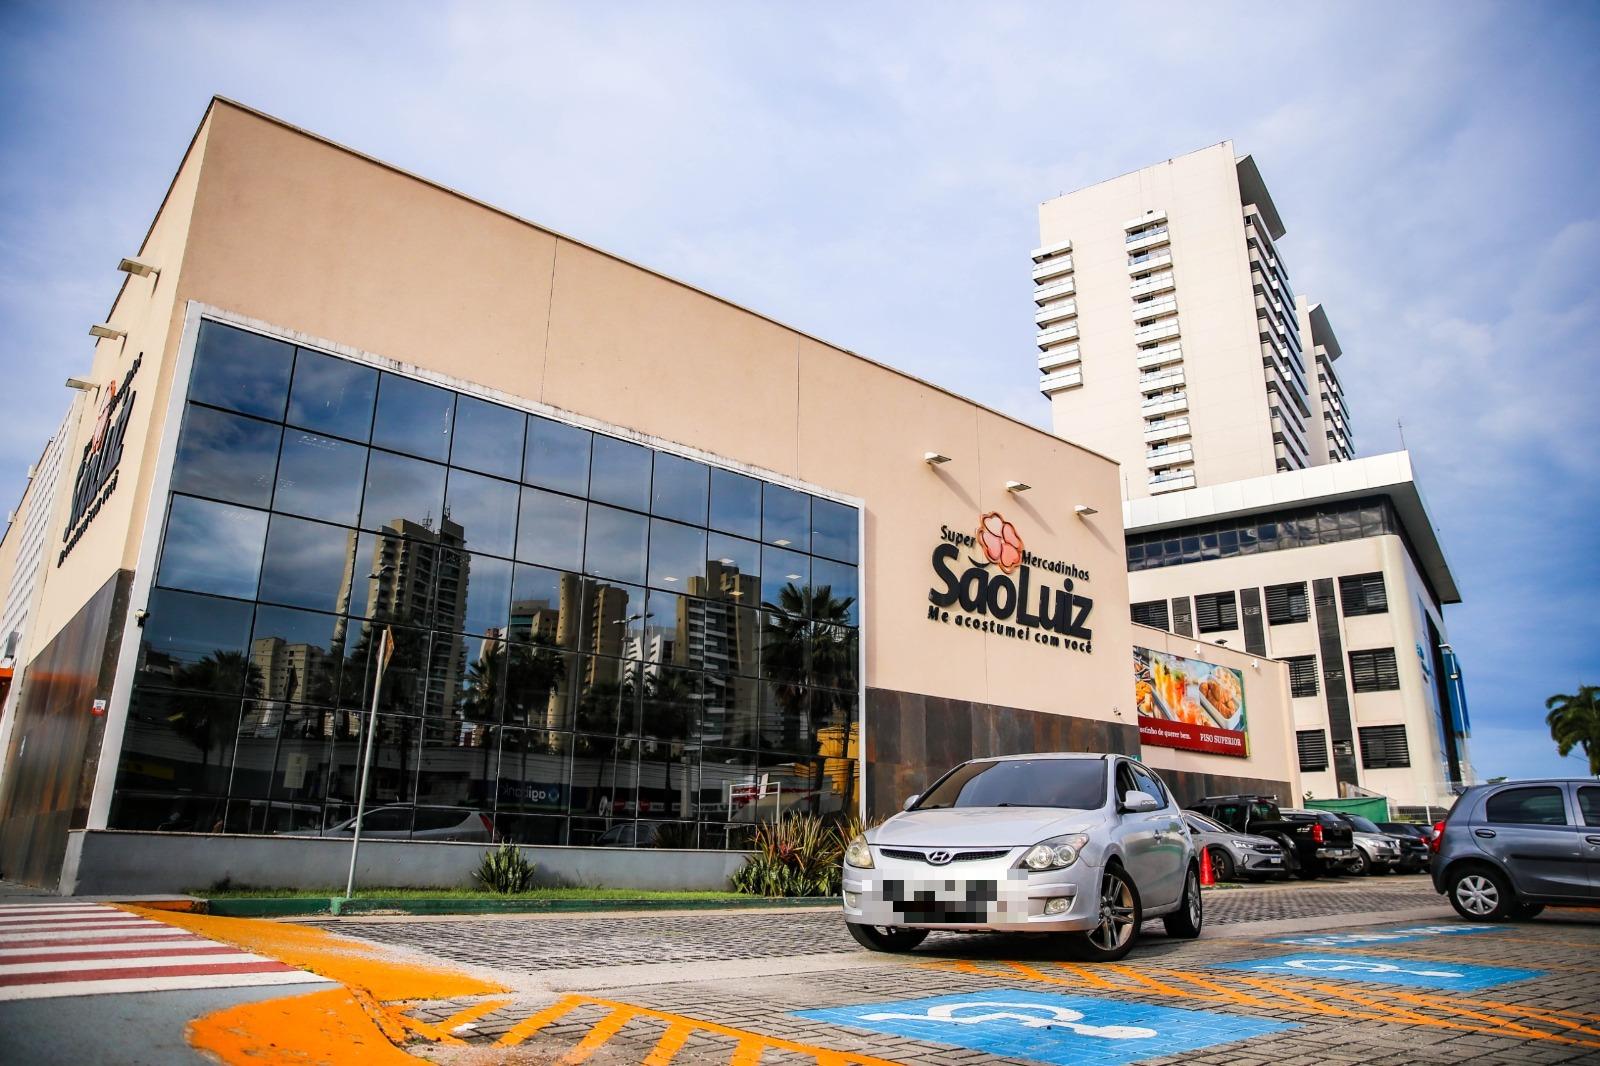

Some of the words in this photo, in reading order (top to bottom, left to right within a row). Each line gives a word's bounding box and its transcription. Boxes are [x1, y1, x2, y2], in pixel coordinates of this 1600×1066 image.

[941, 525, 976, 547] Super
[1022, 550, 1090, 581] Mercadinhos
[928, 606, 949, 622] Me
[955, 614, 1029, 640] acostumei
[1035, 632, 1059, 647] com
[1200, 733, 1213, 742] PISO
[1214, 734, 1242, 747] SUPERIOR
